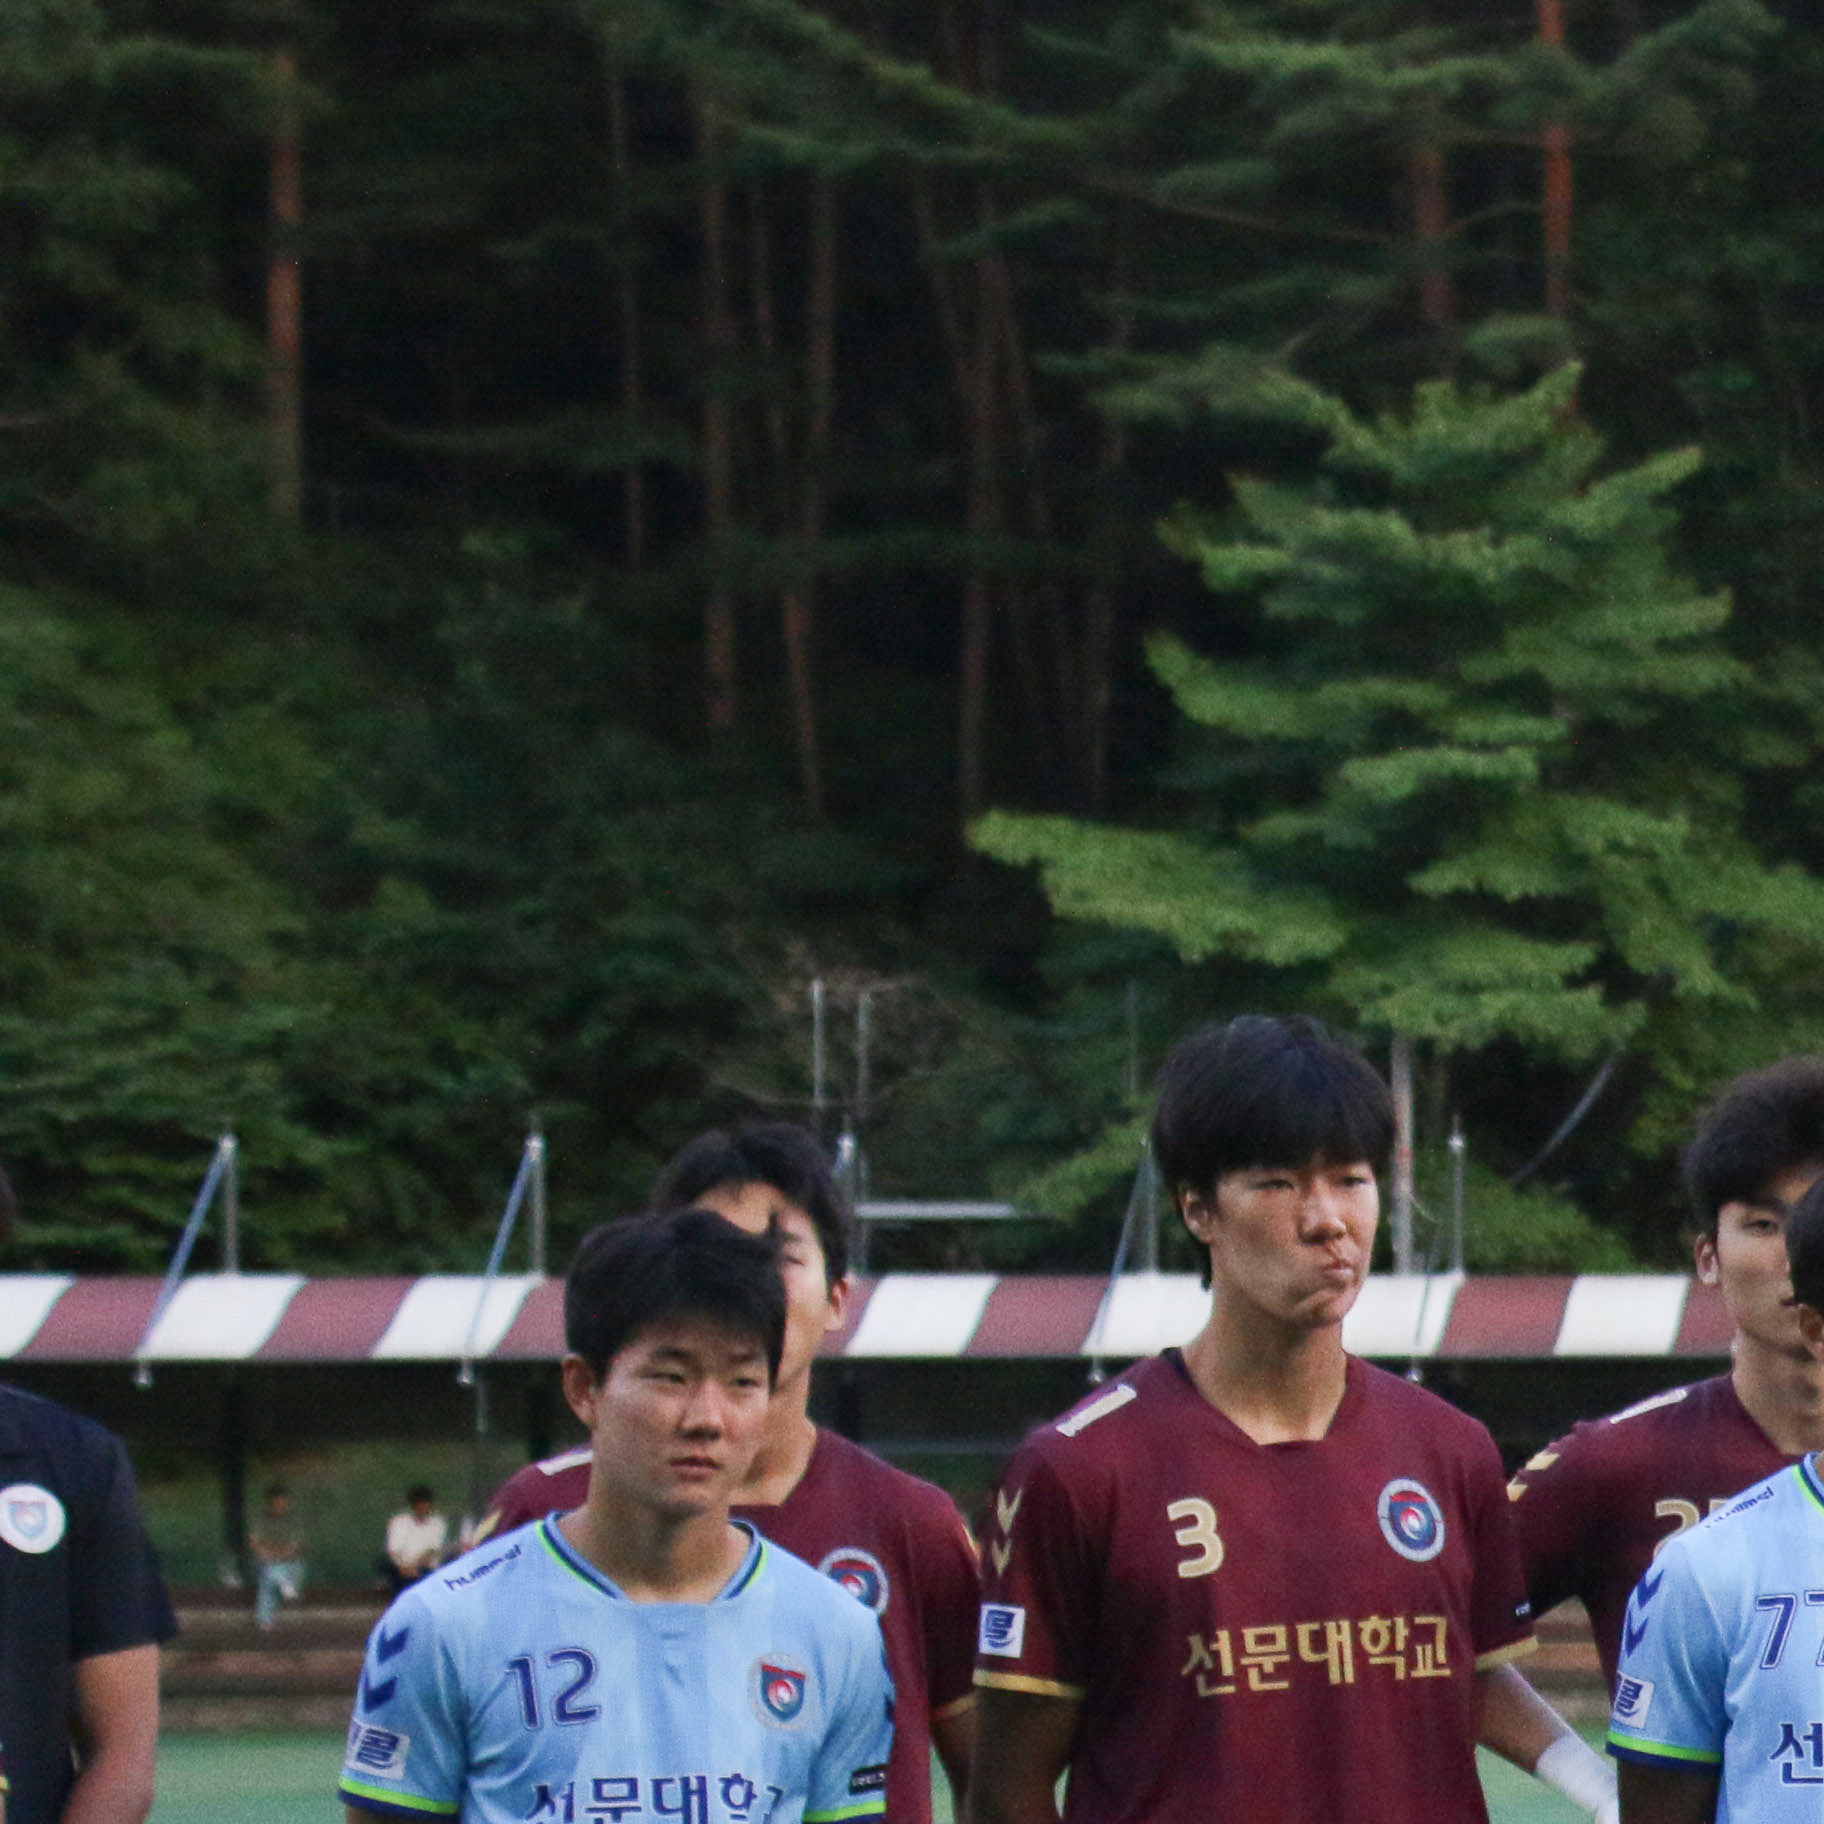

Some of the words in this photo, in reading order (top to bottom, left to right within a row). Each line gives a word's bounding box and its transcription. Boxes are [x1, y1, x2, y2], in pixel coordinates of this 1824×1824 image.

[443, 1543, 523, 1592] hummel
[1166, 1497, 1224, 1579] 3
[504, 1646, 603, 1732] 12
[1180, 1613, 1453, 1698] 선문대학교
